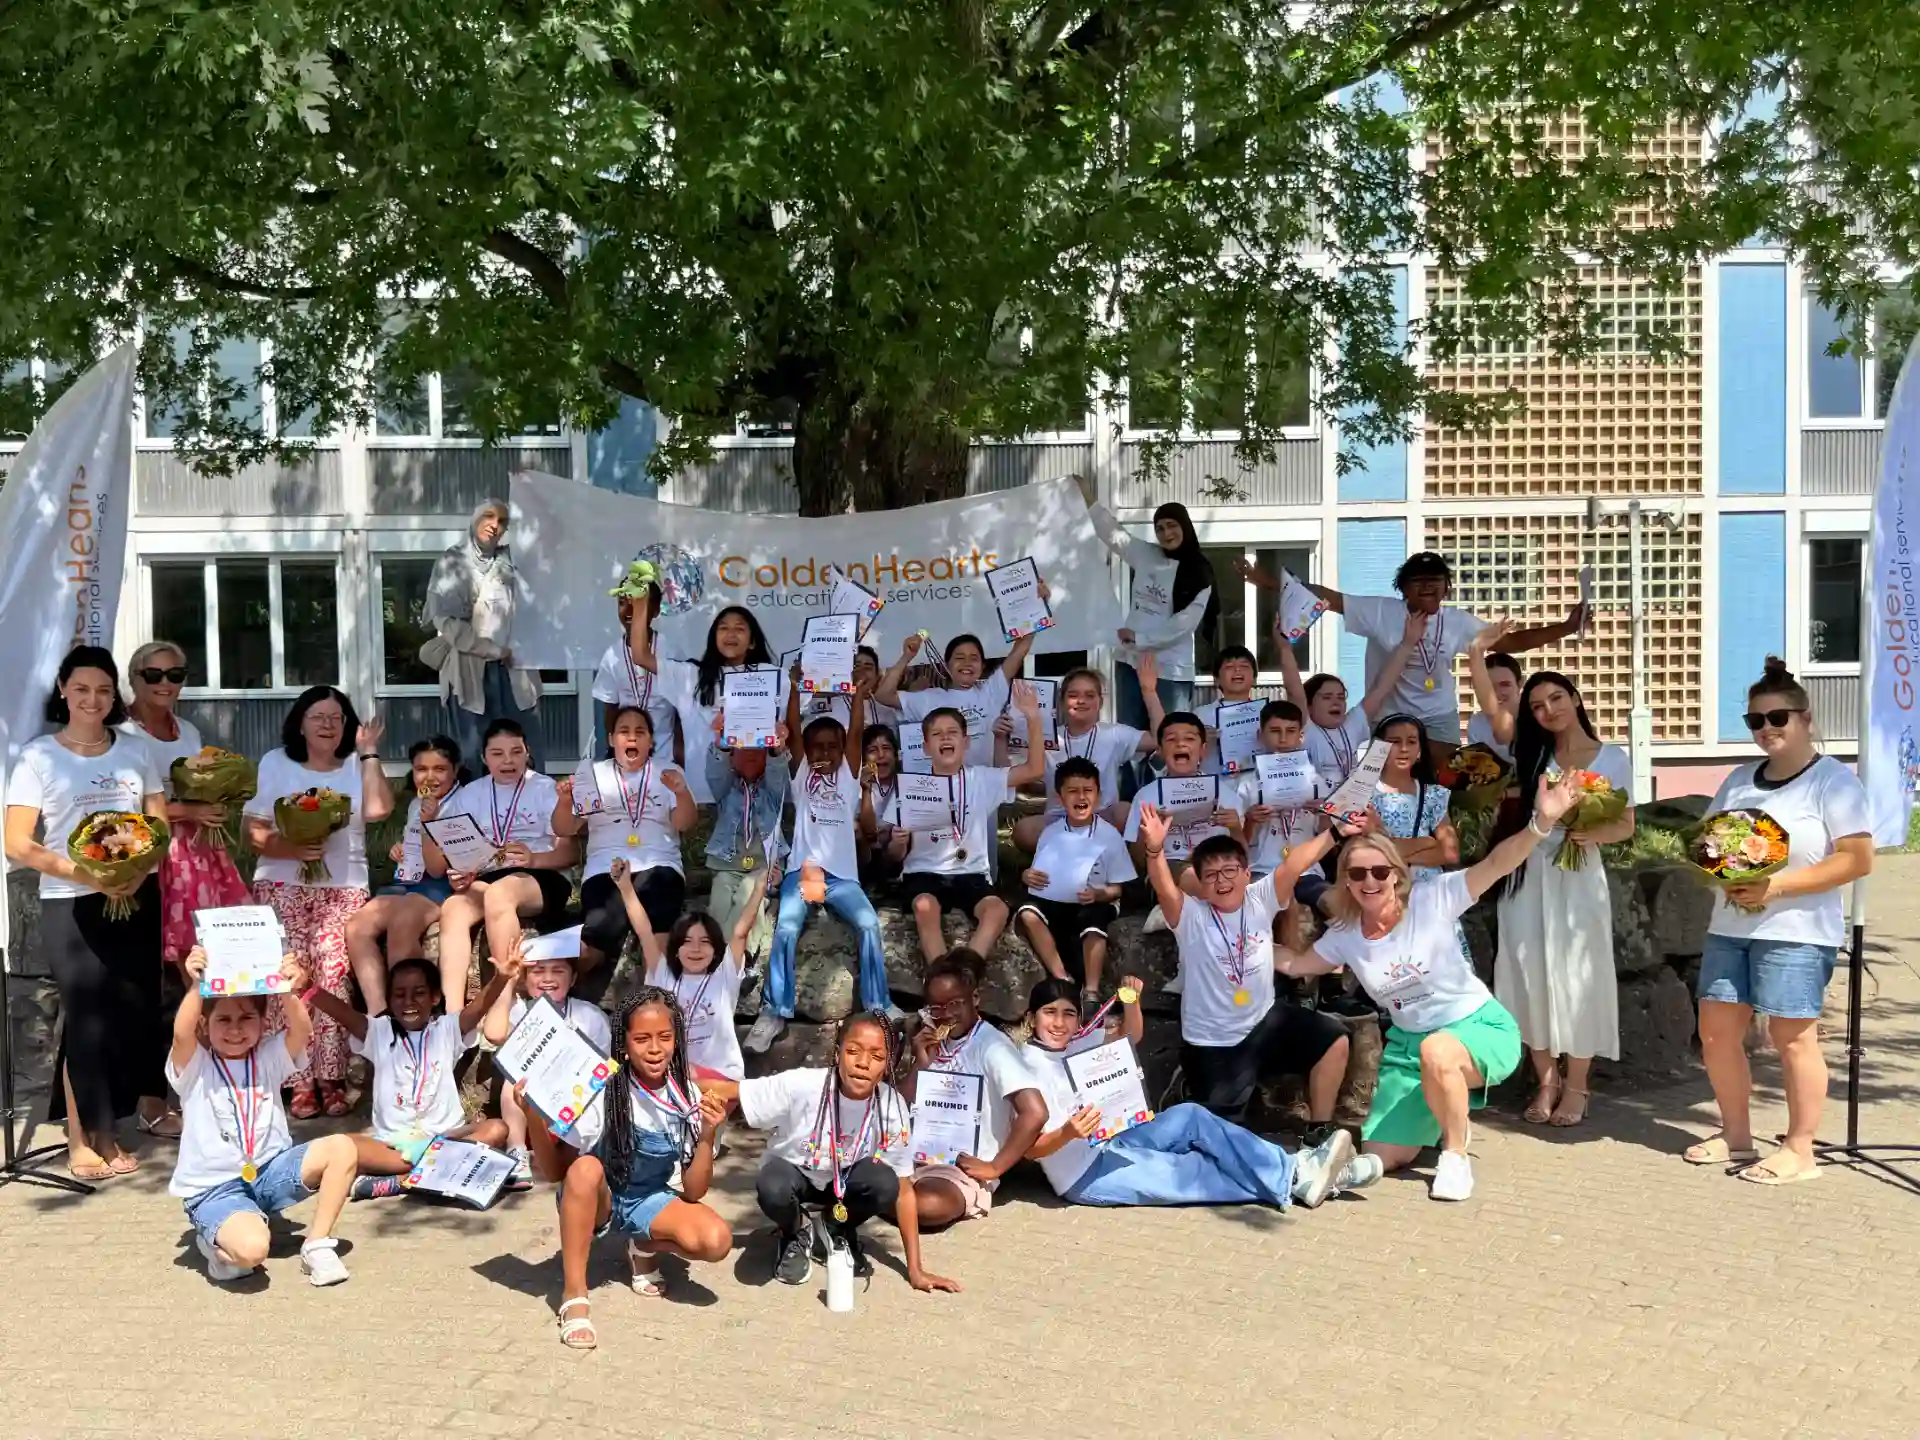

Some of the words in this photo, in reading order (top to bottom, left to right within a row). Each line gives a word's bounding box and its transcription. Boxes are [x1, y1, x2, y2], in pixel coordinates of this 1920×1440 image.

[719, 547, 999, 587] GoldenHearts
[887, 582, 972, 603] services
[520, 1025, 558, 1072] URKUNDE
[1086, 1067, 1129, 1089] URKUNDE
[924, 1099, 968, 1111] URKUNDE
[461, 1155, 488, 1188] URKUNDE
